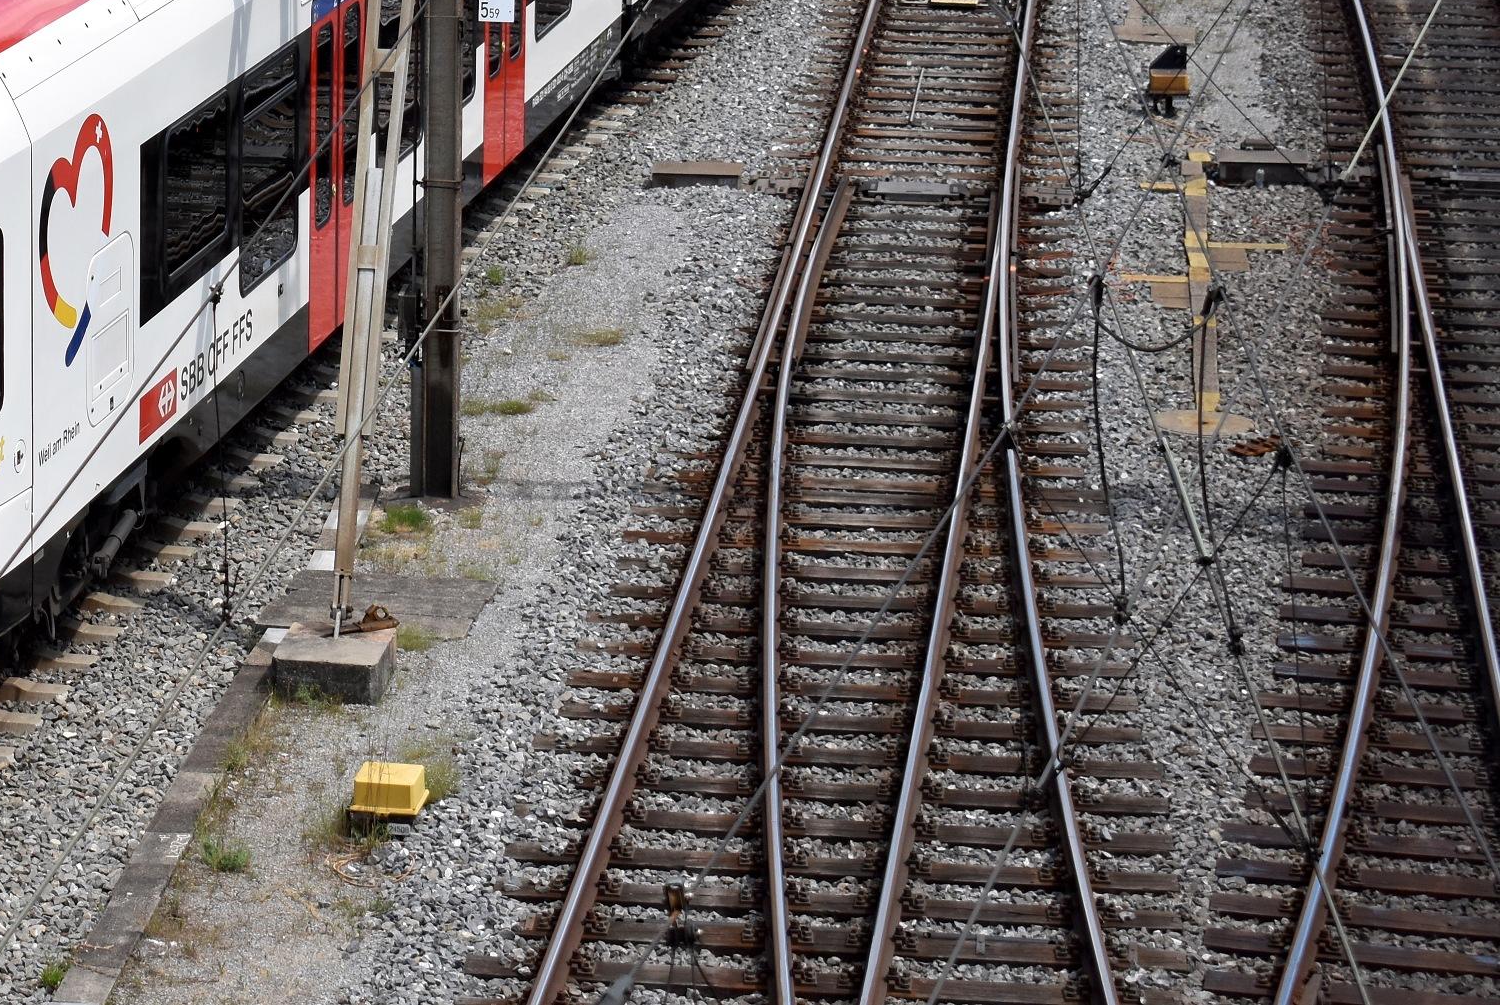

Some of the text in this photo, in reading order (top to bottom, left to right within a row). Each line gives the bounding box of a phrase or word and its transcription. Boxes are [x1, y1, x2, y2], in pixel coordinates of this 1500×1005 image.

[180, 352, 205, 401] SBB
[232, 308, 253, 355] FFS
[38, 420, 81, 467] Weil am Rhein
